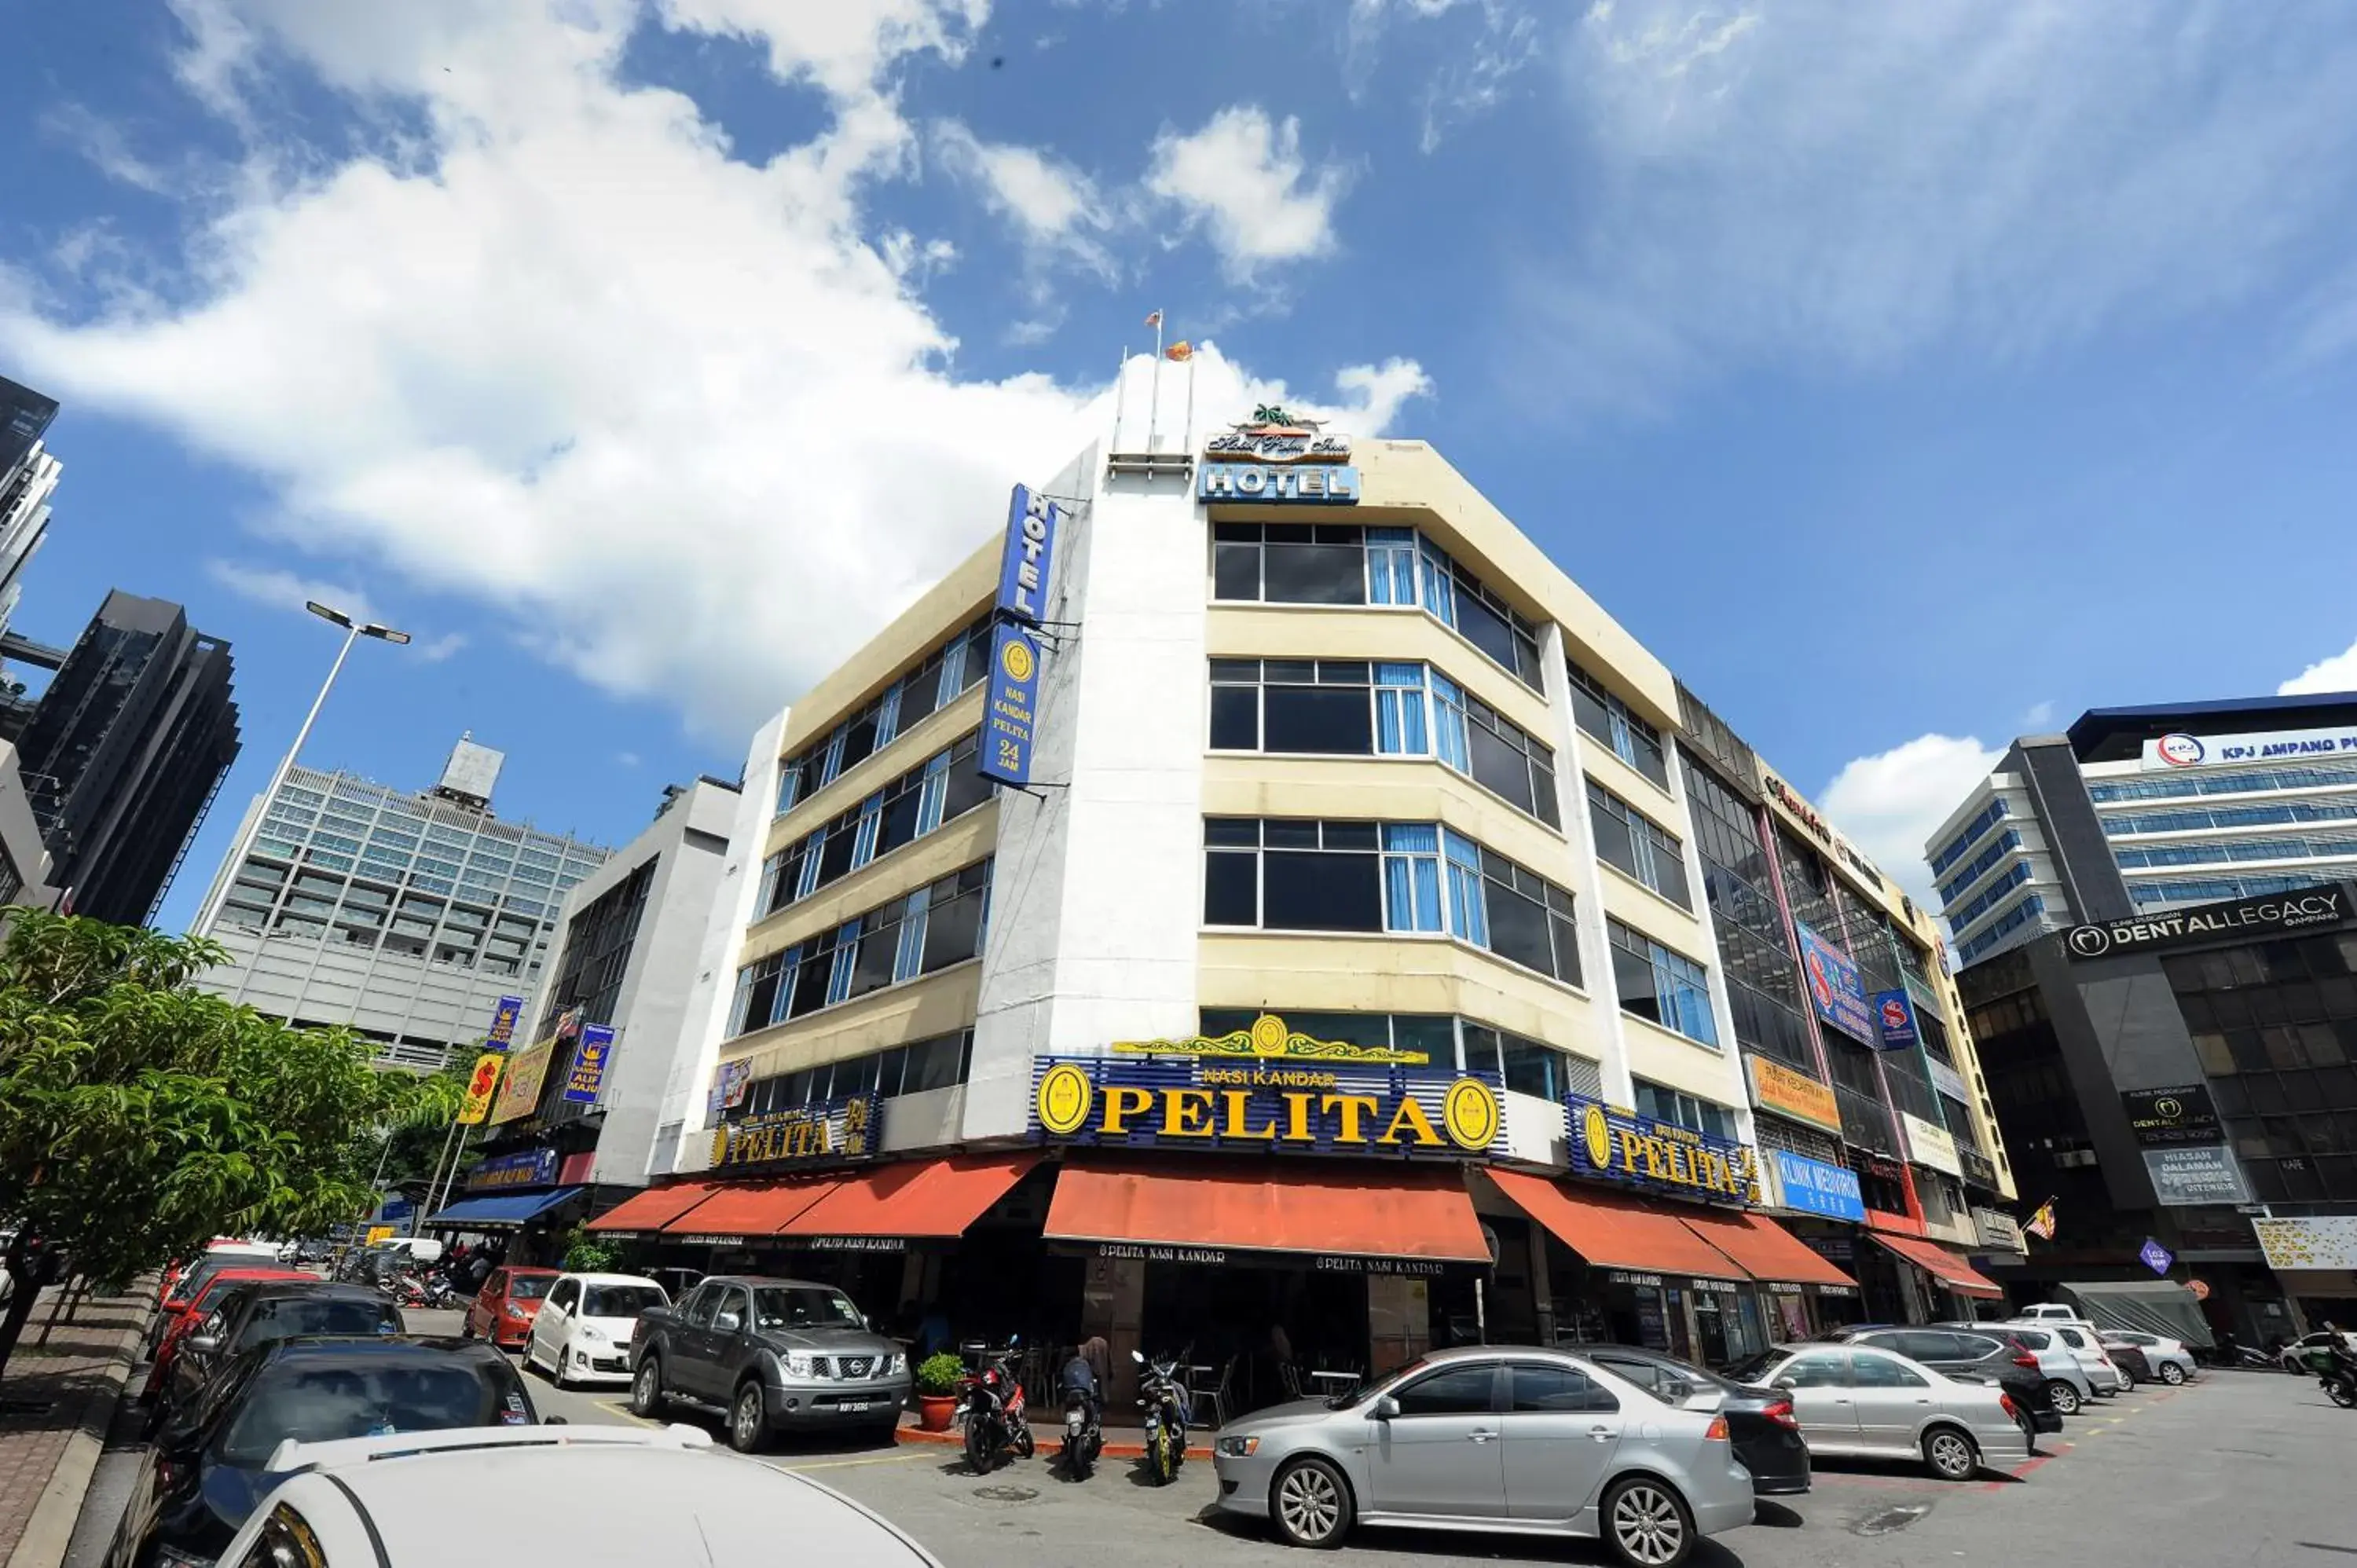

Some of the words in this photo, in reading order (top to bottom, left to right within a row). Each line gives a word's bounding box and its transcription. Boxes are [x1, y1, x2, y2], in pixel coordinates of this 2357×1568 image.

[1206, 466, 1351, 495] HOTEL
[1015, 488, 1049, 615] HOTEL
[1005, 685, 1026, 704] NASI
[994, 698, 1032, 724] KANDAR
[993, 717, 1028, 741] PELITA
[999, 739, 1020, 760] 24
[2222, 746, 2256, 760] KPJ
[2262, 739, 2336, 757] AMPANG
[997, 760, 1020, 771] JAM
[1203, 1069, 1249, 1084] NASI
[1253, 1069, 1336, 1087] KANDAR
[1096, 1087, 1450, 1146] PELITA
[731, 1121, 830, 1163] PELITA
[1619, 1130, 1739, 1195] PELITA
[1109, 1245, 1145, 1258] PELITA
[1149, 1247, 1174, 1260] NASI
[1178, 1249, 1226, 1262] KANDAR
[1325, 1258, 1362, 1270] PELITA
[1367, 1262, 1392, 1272] NASI
[1396, 1262, 1444, 1275] KANDAR
